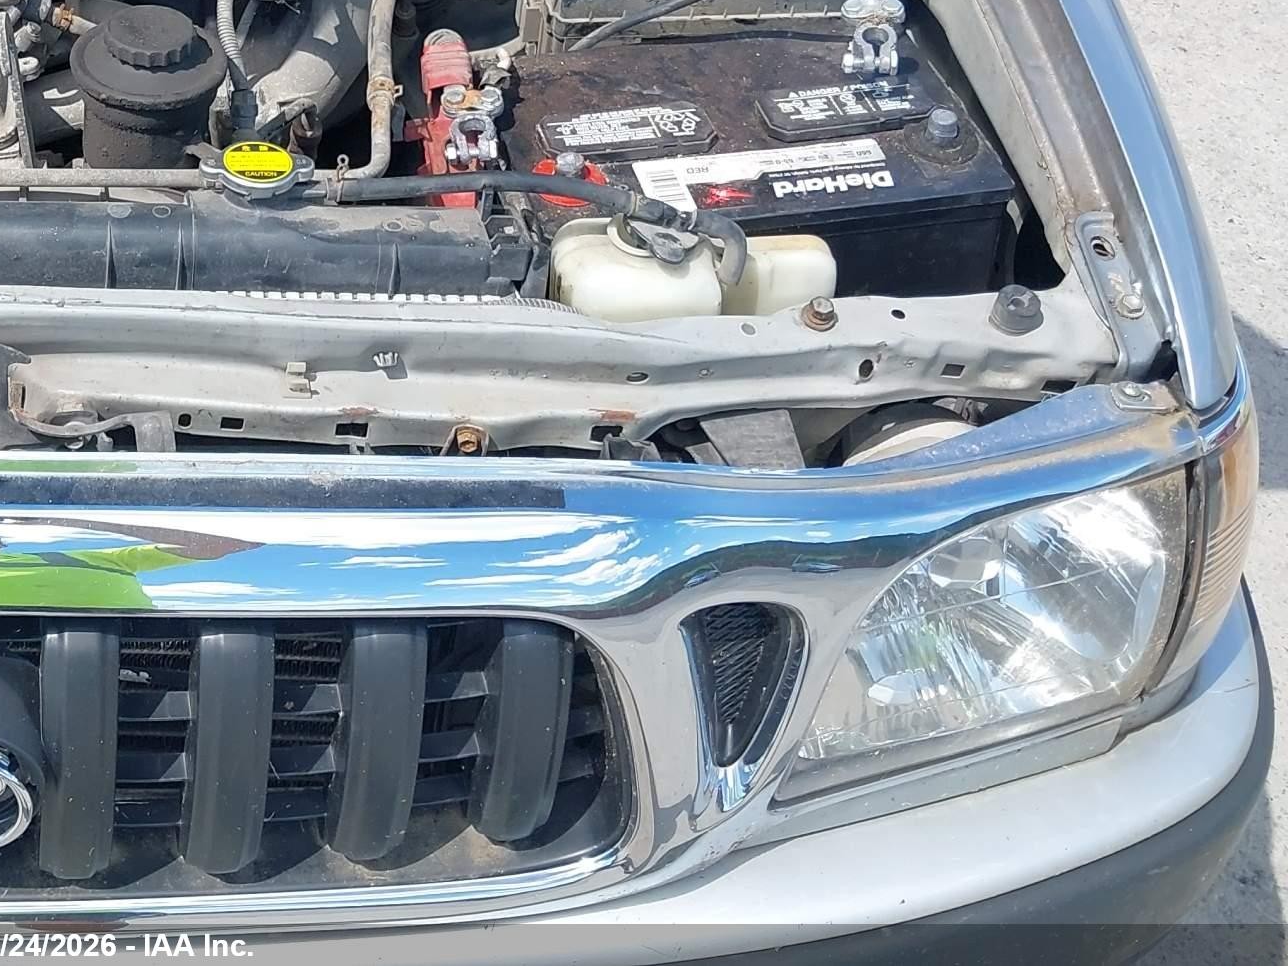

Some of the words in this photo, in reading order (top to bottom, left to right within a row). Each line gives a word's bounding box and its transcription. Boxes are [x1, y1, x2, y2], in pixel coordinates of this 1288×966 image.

[800, 87, 841, 97] DANGER
[686, 166, 709, 174] RED
[773, 170, 895, 198] DieHard
